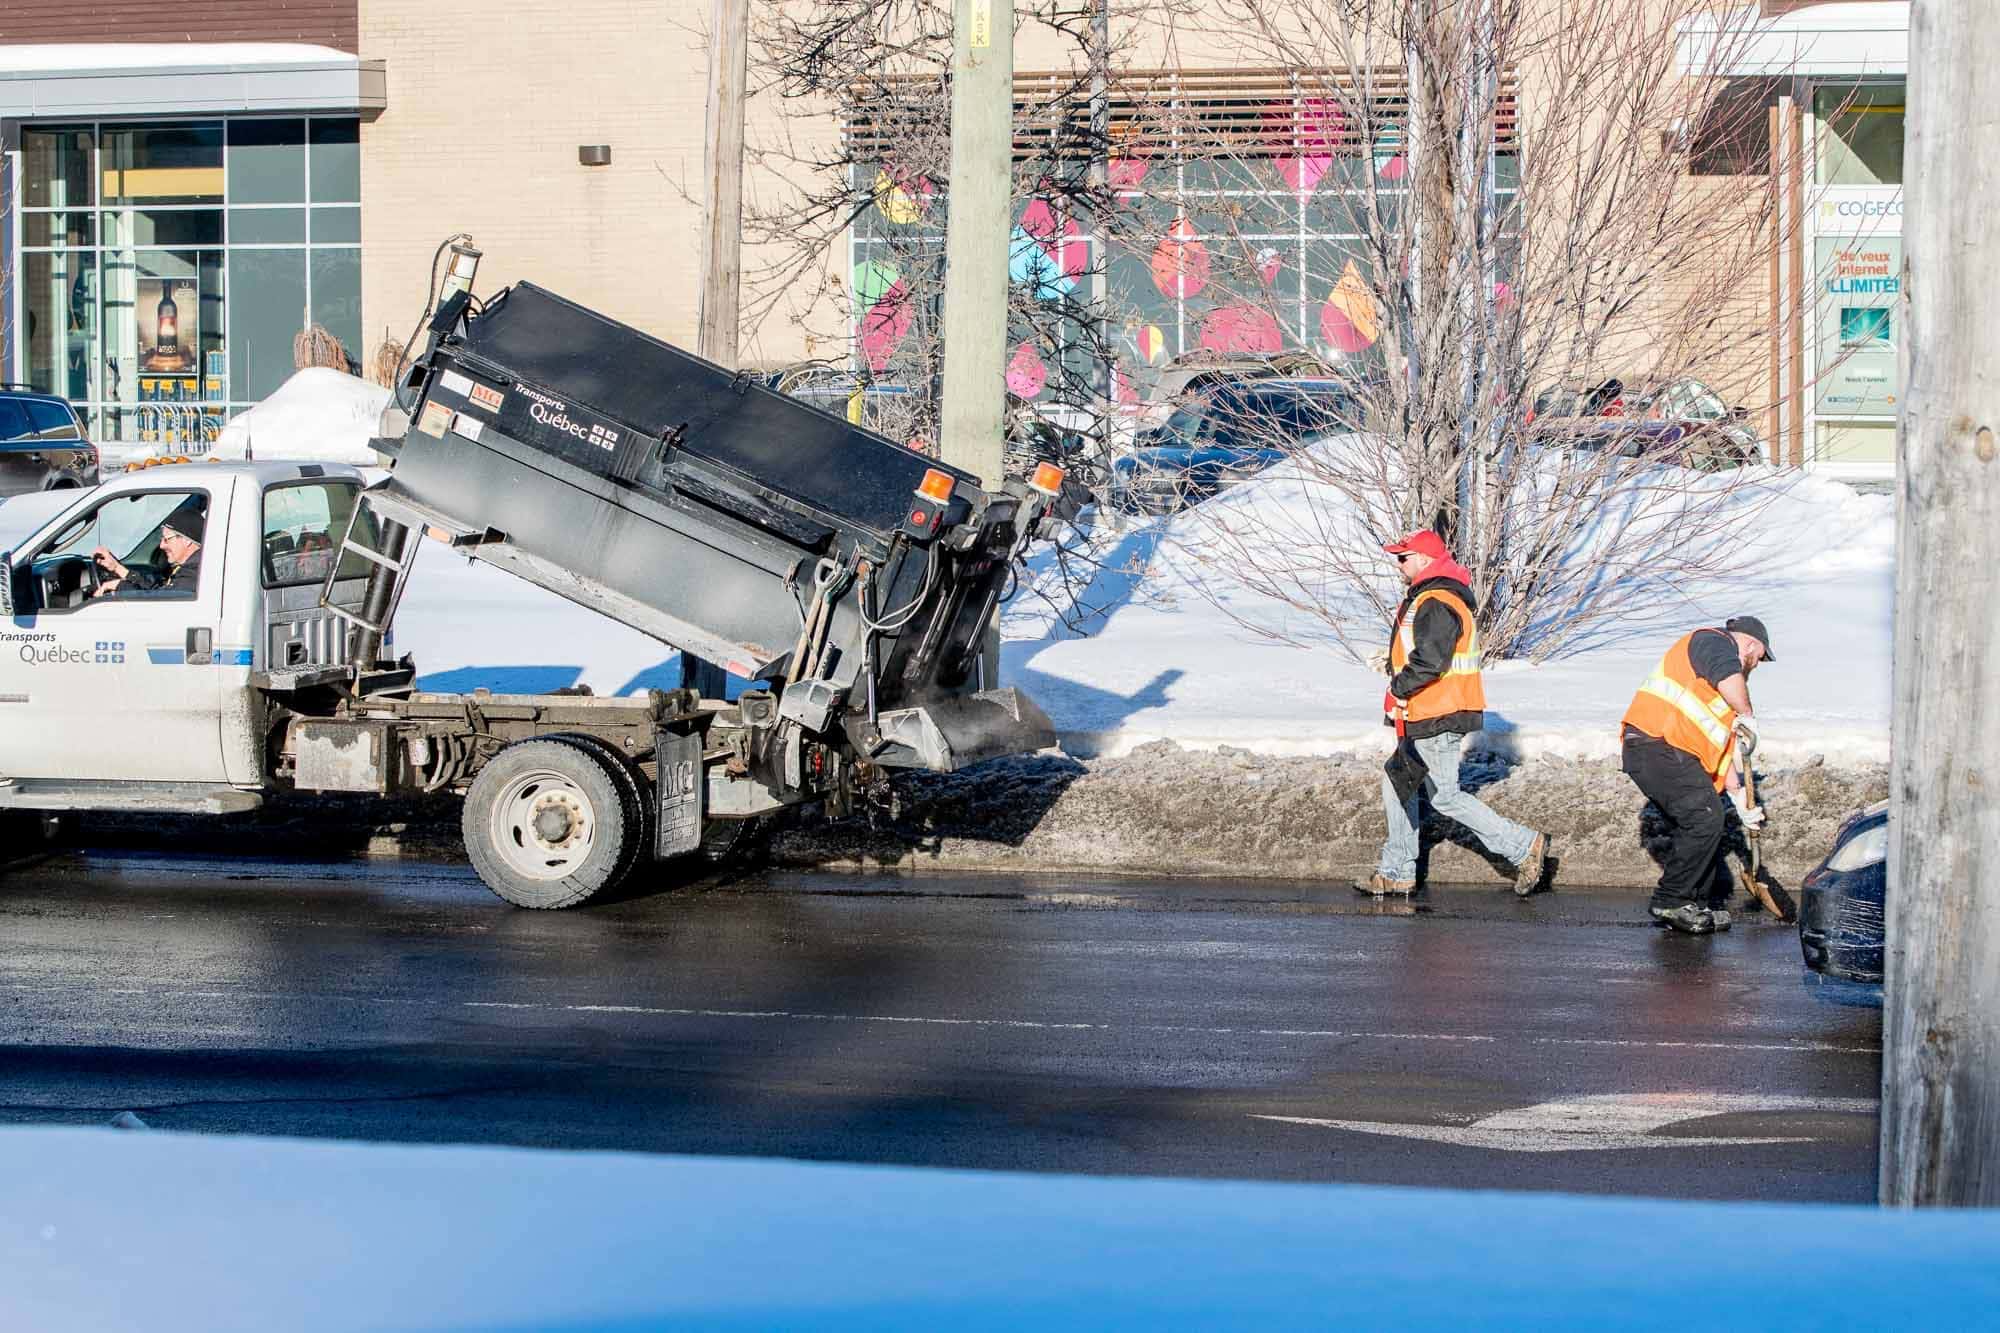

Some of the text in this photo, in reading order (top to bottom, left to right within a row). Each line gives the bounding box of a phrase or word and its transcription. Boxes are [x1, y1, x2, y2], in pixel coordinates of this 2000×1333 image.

[1860, 252, 1890, 262] veux
[1838, 264, 1889, 276] Internet
[514, 383, 566, 411] Transports
[530, 403, 588, 439] Québec
[0, 632, 57, 643] ransports
[20, 644, 91, 666] Québec
